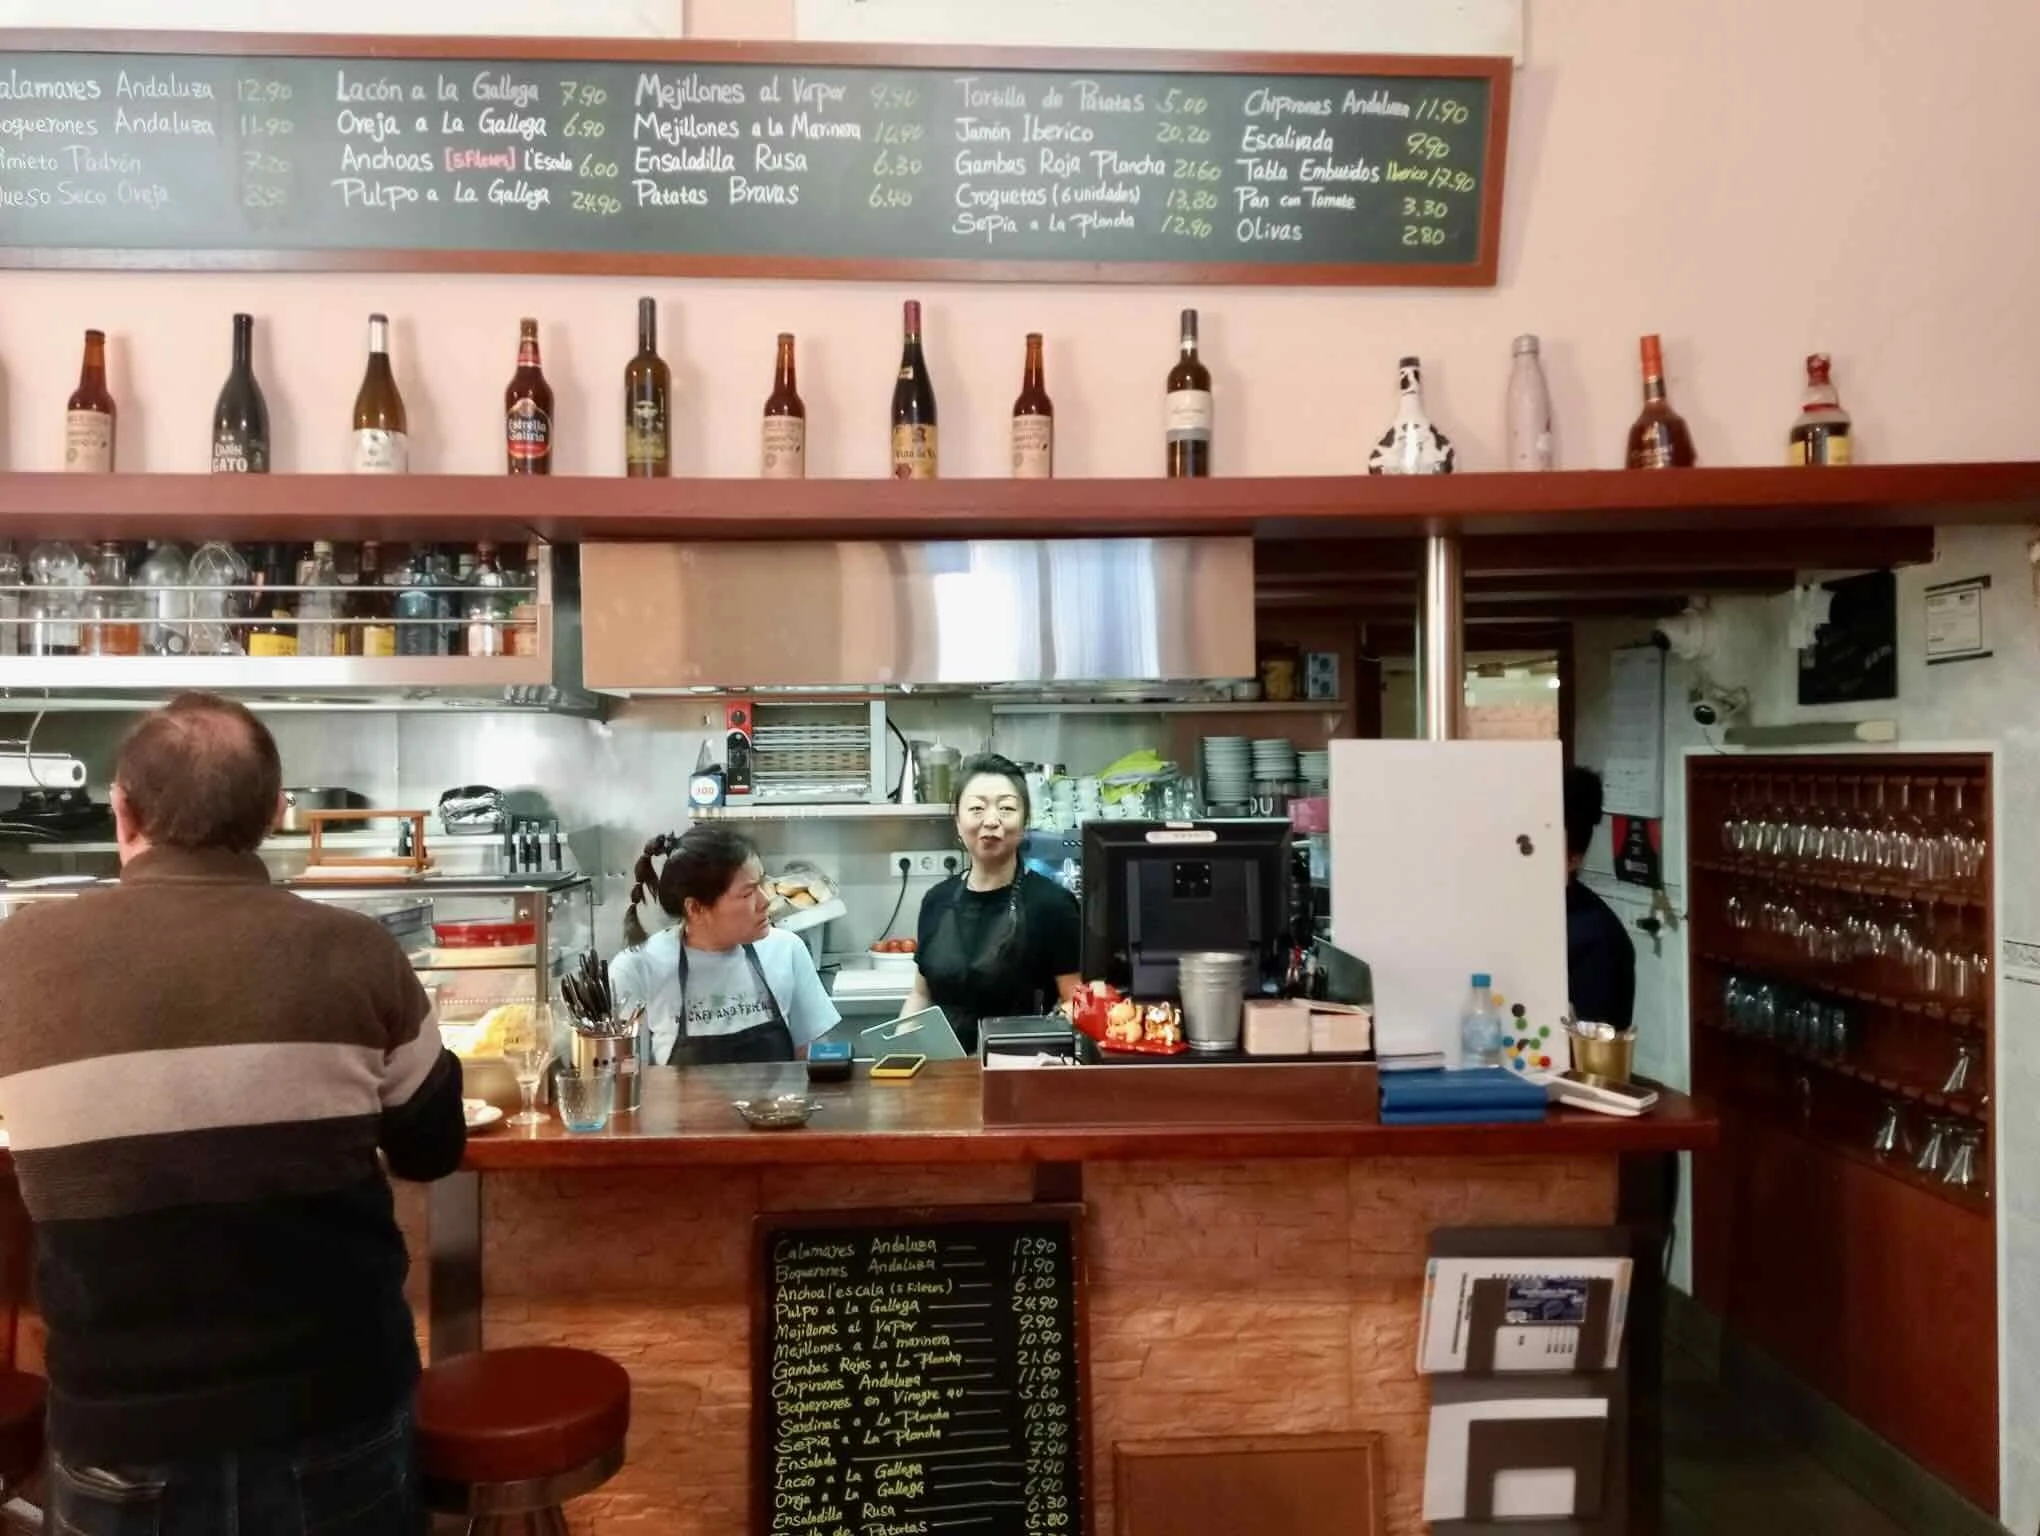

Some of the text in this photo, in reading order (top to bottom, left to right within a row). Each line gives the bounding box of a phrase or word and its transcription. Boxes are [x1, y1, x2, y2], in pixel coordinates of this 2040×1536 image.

[116, 70, 216, 100] Andaluza
[238, 79, 293, 102] 12.90
[337, 70, 403, 102] Lacón
[412, 84, 427, 100] a
[472, 70, 539, 108] Gallega
[560, 81, 608, 106] 7.90
[635, 73, 745, 110] Mejillones
[953, 78, 1208, 114] Tortilla de Patatas 5.00
[115, 107, 215, 136] Andaluza
[1342, 90, 1410, 118] Andaluza
[1415, 99, 1469, 124] 11.90
[415, 117, 429, 132] a
[479, 107, 547, 141] Gallega
[564, 112, 605, 137] 6.90
[633, 112, 739, 145] Mejillones
[752, 122, 761, 137] a
[1156, 121, 1212, 145] 20.20
[1241, 124, 1450, 160] Escalivada 9.90
[341, 143, 434, 171] Anchoas
[580, 153, 618, 177] 6.00
[635, 144, 923, 176] Ensaladilla Rusa 6.30
[955, 147, 1222, 181] Gambas Roja Plancha 21.60
[1235, 158, 1288, 182] Tabla
[331, 177, 418, 211] Pulpo
[427, 188, 439, 202] a
[488, 178, 550, 210] Gallega
[571, 190, 621, 216] 24.90
[632, 179, 709, 208] Patatas
[729, 175, 800, 205] Bravas
[955, 183, 1047, 211] Croquetas
[1234, 187, 1268, 213] Pan
[1303, 187, 1356, 210] Tomate
[1402, 197, 1448, 218] 3.30
[952, 213, 1018, 243] Sepia
[1237, 216, 1446, 246] Olivas 2.80
[773, 1235, 1057, 1263] Calamares Andaluza 12.90
[1011, 1257, 1055, 1274] 11.90
[1014, 1276, 1056, 1293] 6.00
[773, 1303, 819, 1322] Pulpo
[826, 1306, 835, 1315] a
[1011, 1296, 1059, 1312] 24.90
[1020, 1314, 1056, 1330] 9.90
[853, 1342, 862, 1350] a
[1018, 1330, 1062, 1345] 10.90
[772, 1360, 830, 1380] Gambas
[880, 1361, 887, 1369] a
[1017, 1349, 1061, 1365] 21.60
[771, 1366, 1061, 1399] Chipirones Andaluza 11.90
[777, 1397, 853, 1419] Boquerones
[864, 1396, 880, 1407] en
[1019, 1384, 1059, 1399] 5.60
[777, 1416, 841, 1437] Sardinas
[853, 1417, 861, 1427] a
[1023, 1402, 1067, 1419] 10.90
[1025, 1422, 1069, 1438] 12.90
[775, 1440, 1068, 1473] Ensalada 7.90
[826, 1475, 835, 1483] a
[1026, 1459, 1064, 1475] 7.90
[1024, 1476, 1063, 1495] 6.90
[772, 1495, 1068, 1528] Ensaladilla Rusa 6.30
